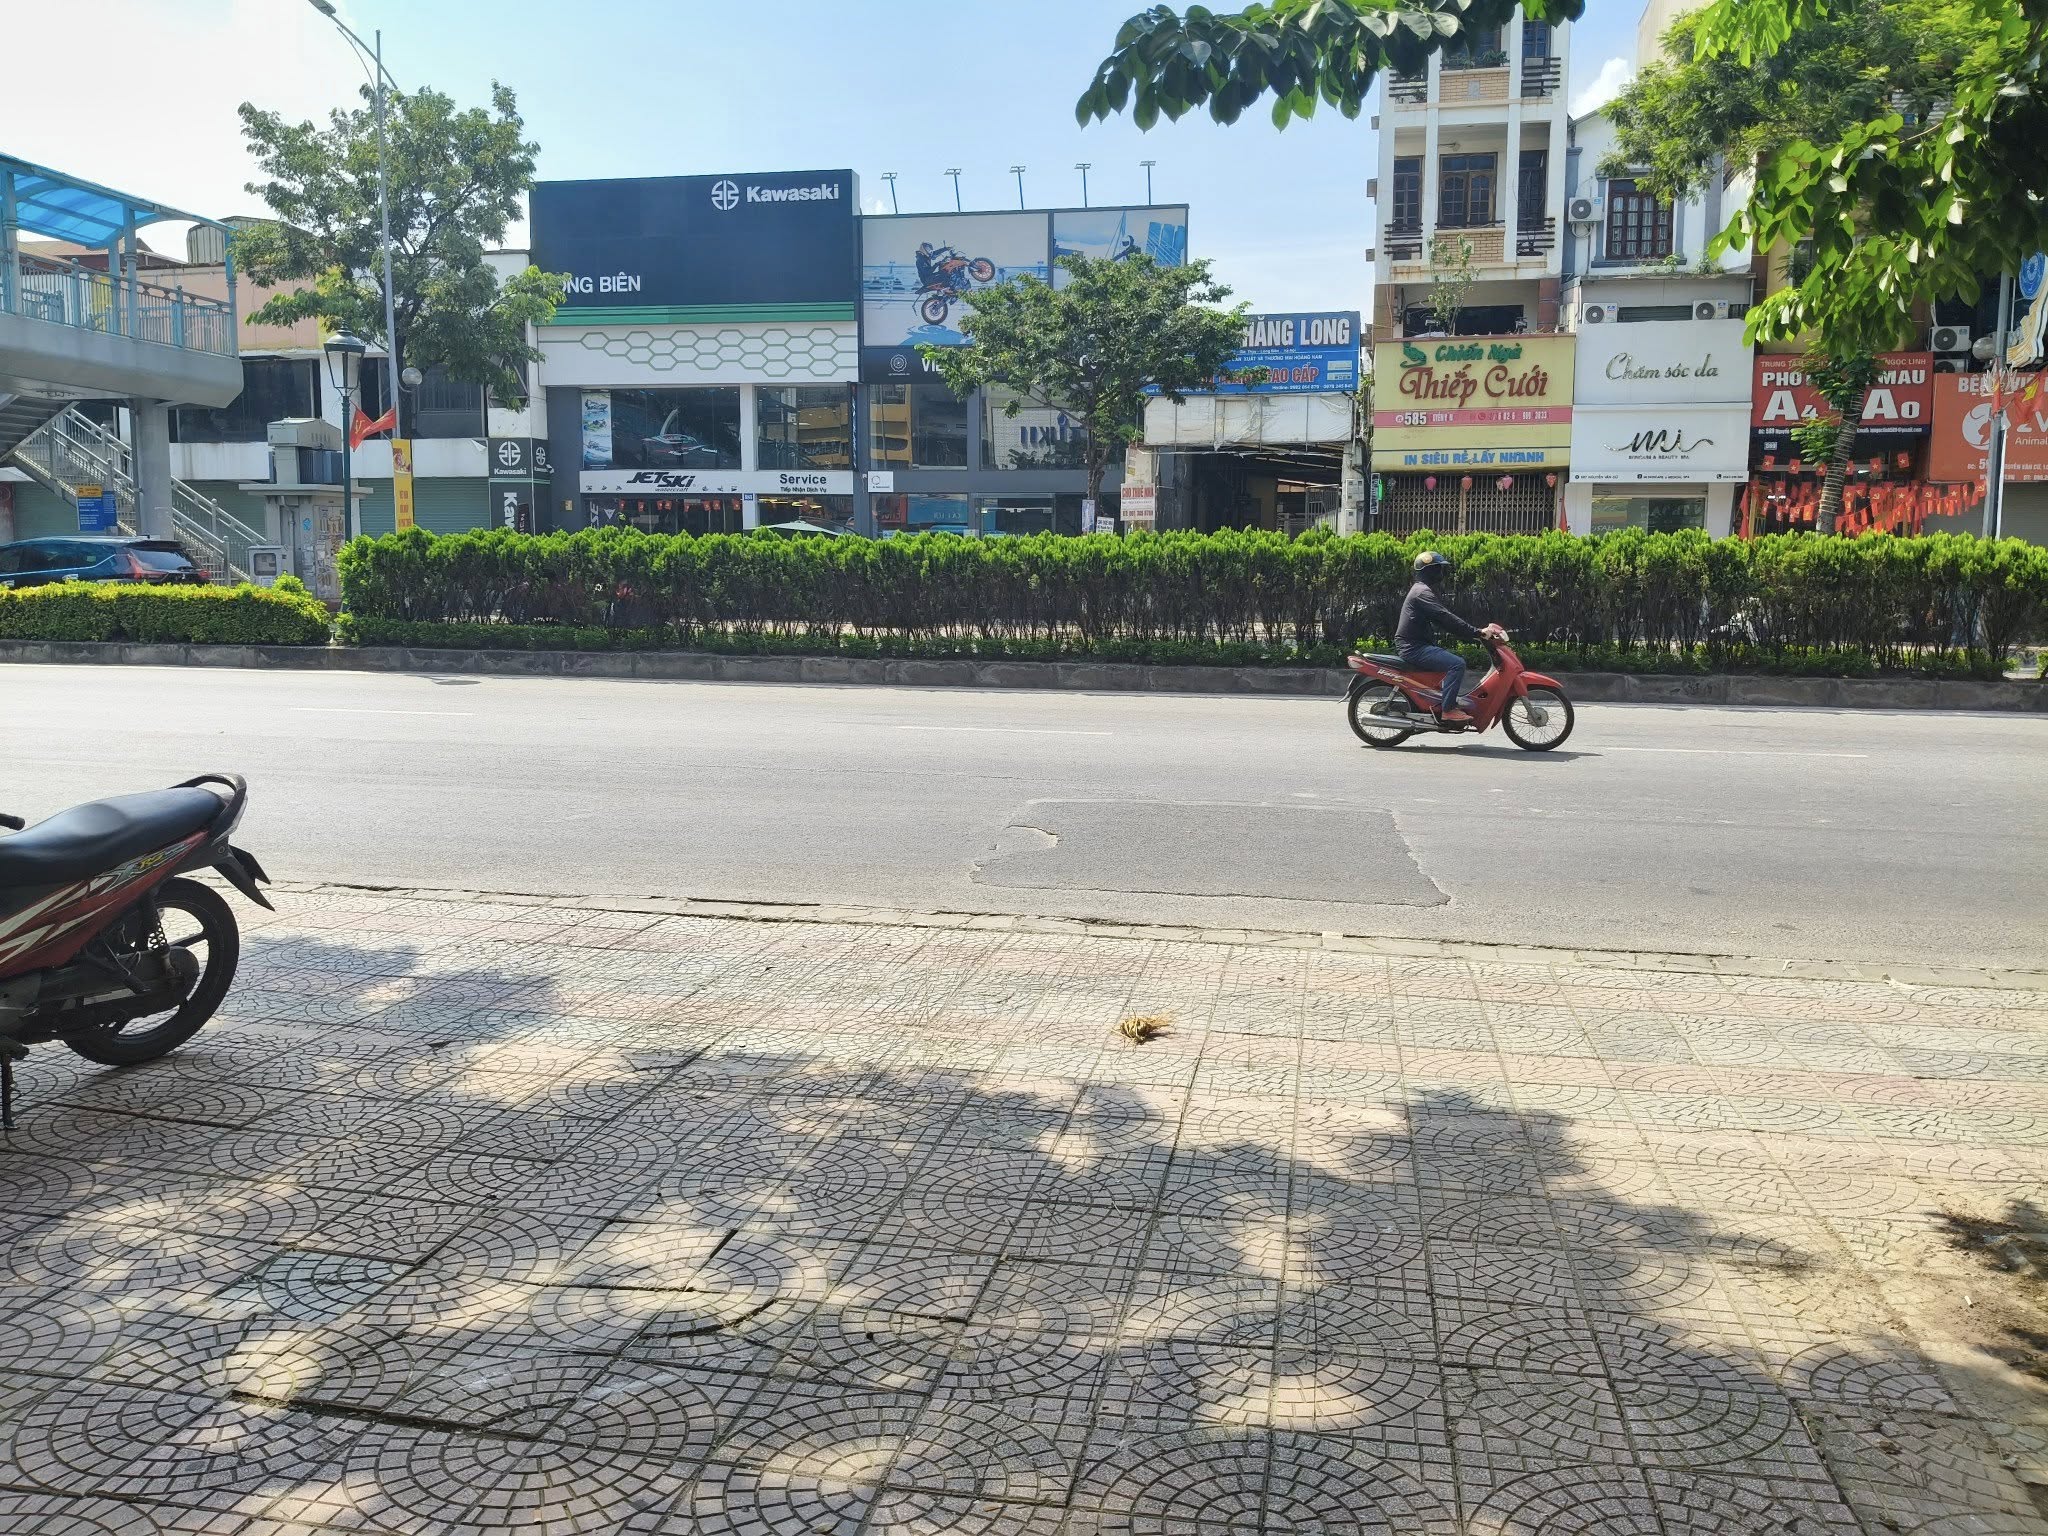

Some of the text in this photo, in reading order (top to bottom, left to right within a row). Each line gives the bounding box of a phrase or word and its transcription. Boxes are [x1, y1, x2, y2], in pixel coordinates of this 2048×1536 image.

[746, 183, 840, 203] Kawasaki
[599, 271, 641, 293] BIÊN
[1243, 316, 1350, 348] HĂNG LONG
[1605, 352, 1720, 381] Chăm sóc da
[1761, 361, 1787, 369] TRUNG
[1908, 358, 1927, 366] LINH
[1292, 361, 1320, 384] CẤP
[1399, 363, 1478, 408] Thiếp
[1484, 364, 1549, 398] Cưới
[1404, 411, 1427, 425] 585
[2015, 436, 2048, 446] Animal
[1404, 454, 1418, 466] IN
[1421, 451, 1449, 464] SIÊU
[494, 467, 527, 475] Kawasaki
[779, 473, 827, 485] Service
